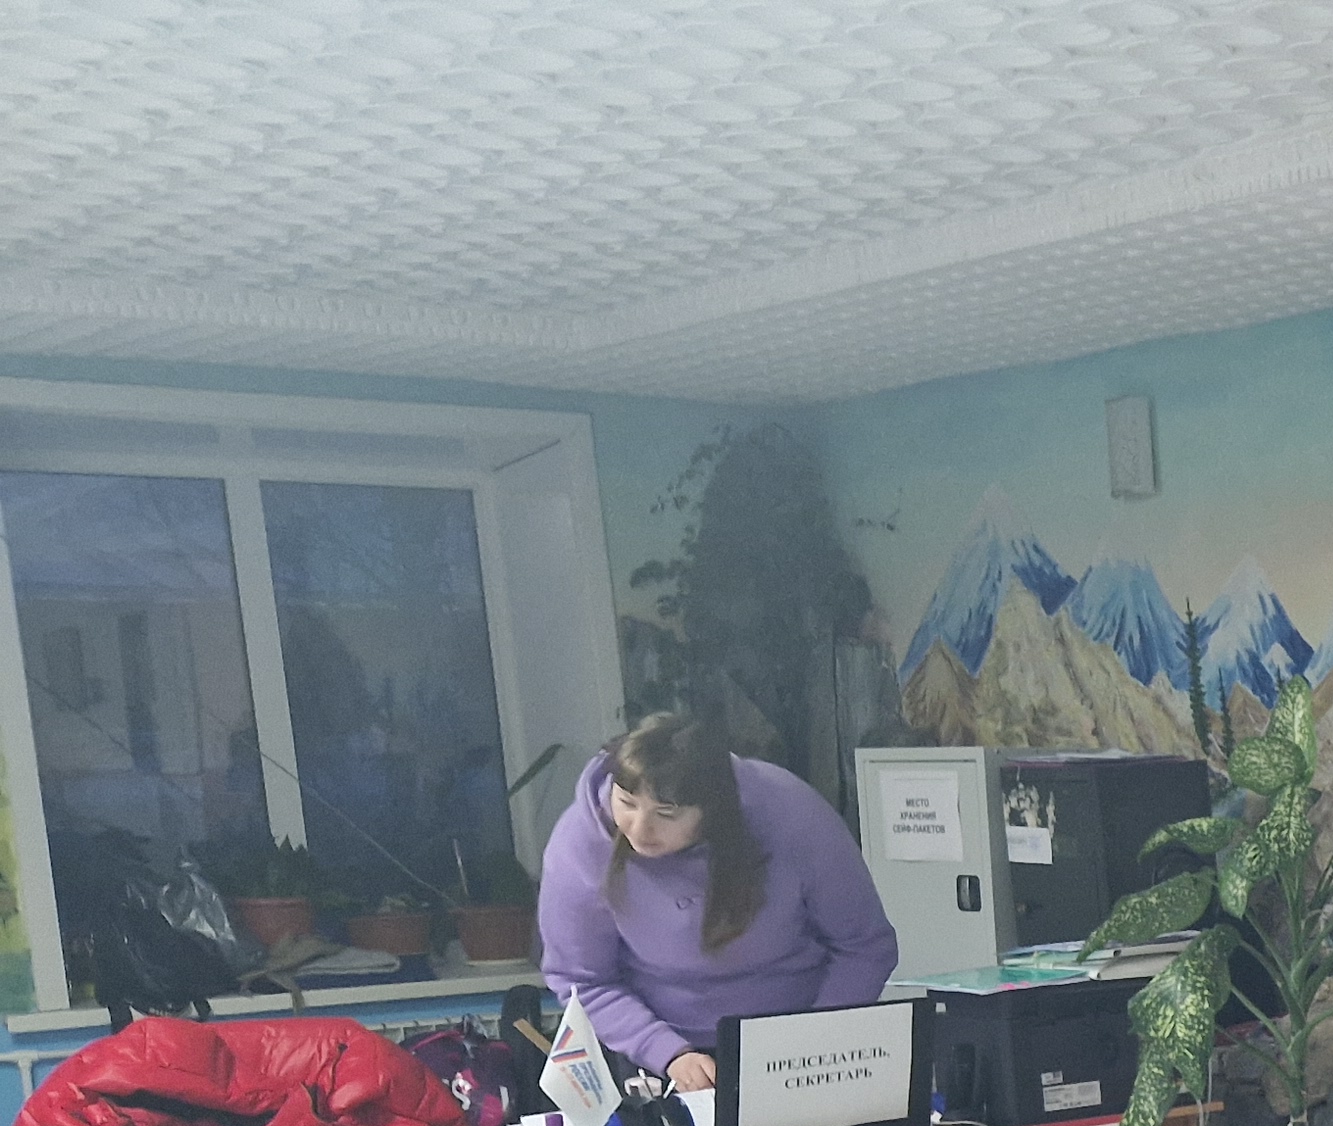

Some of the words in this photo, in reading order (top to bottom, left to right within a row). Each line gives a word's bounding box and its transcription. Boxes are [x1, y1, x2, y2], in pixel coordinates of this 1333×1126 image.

[905, 798, 930, 807] МЕСТО
[900, 811, 937, 820] ХРАНЕНИЯ
[892, 824, 946, 834] СЕЙФ-ПАКЕТОВ
[766, 1046, 890, 1073] ПРЕДСЕДАТЕЛЬ,
[784, 1067, 873, 1089] СЕКРЕТАРЬ
